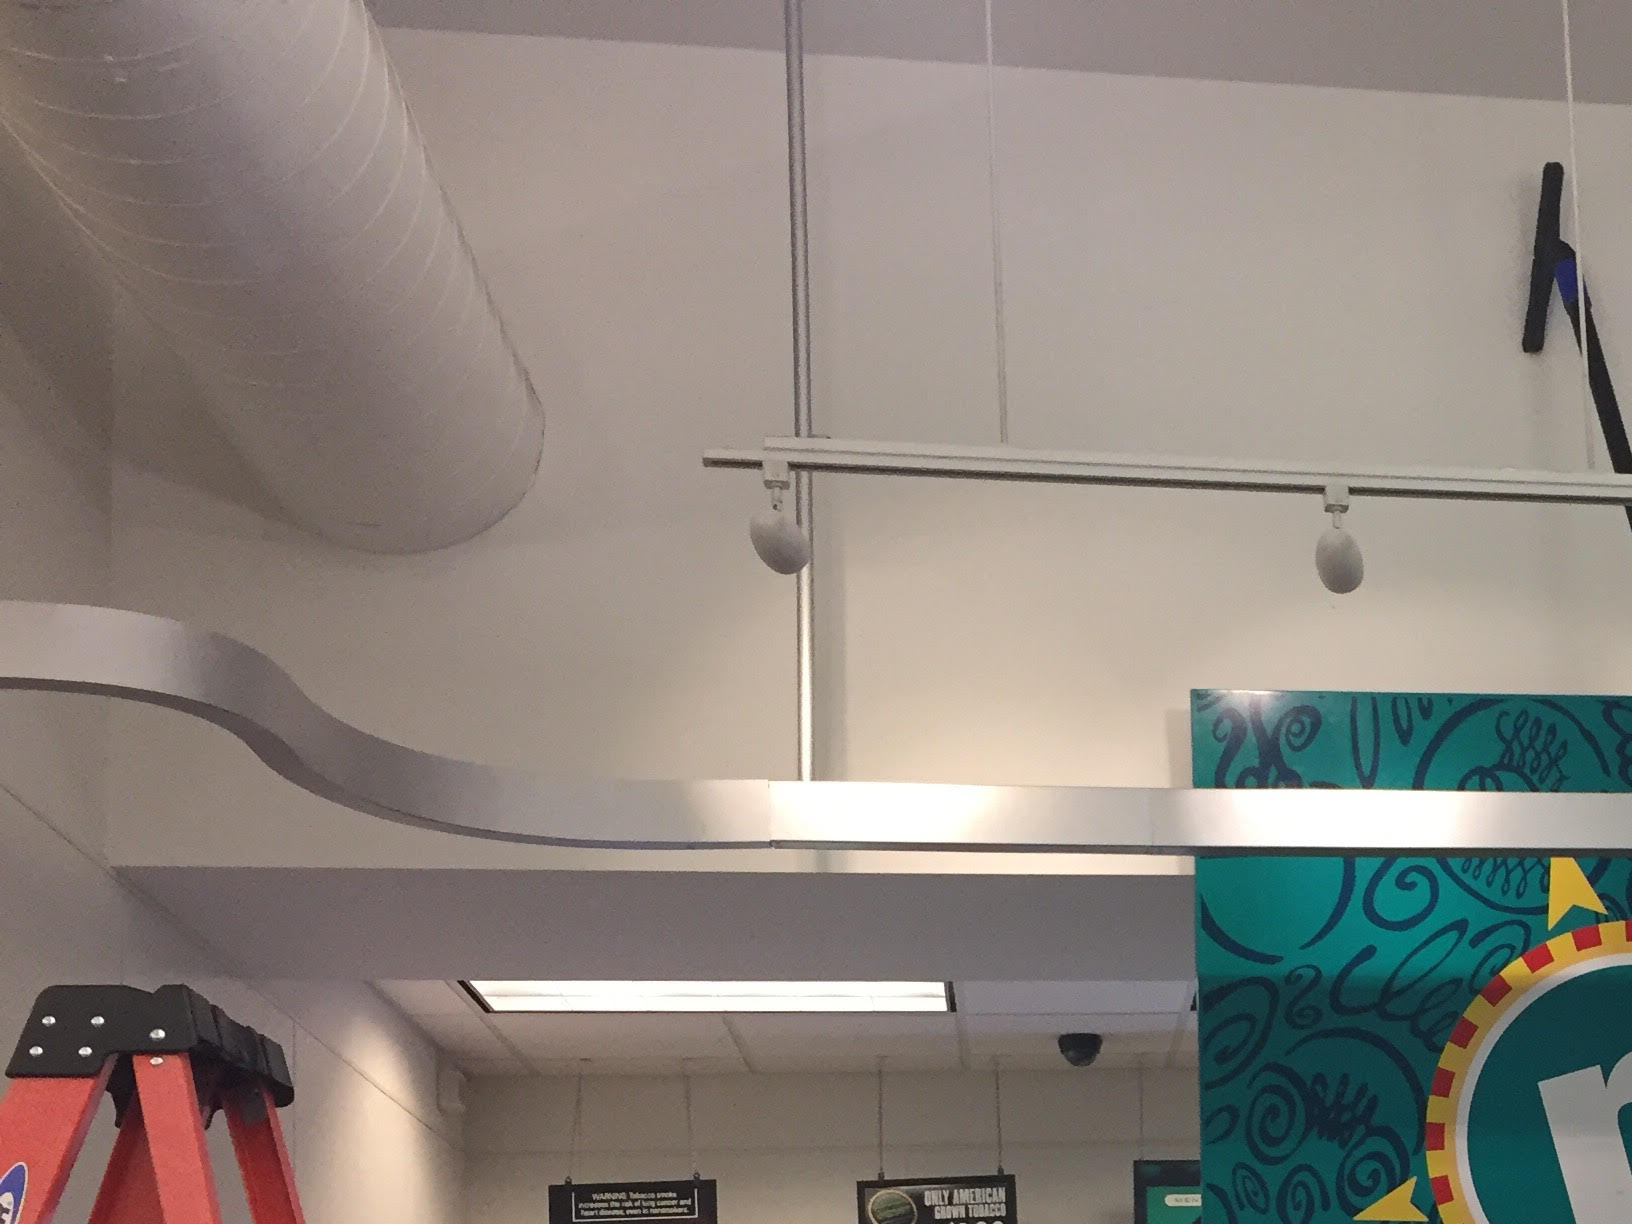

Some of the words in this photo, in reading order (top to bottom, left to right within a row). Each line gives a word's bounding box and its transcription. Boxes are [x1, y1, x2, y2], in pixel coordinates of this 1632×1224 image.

[924, 1190, 949, 1206] ONLY
[953, 1187, 1006, 1206] AMERICAN
[935, 1205, 966, 1220] GROWN
[968, 1203, 1007, 1218] TOBACCO
